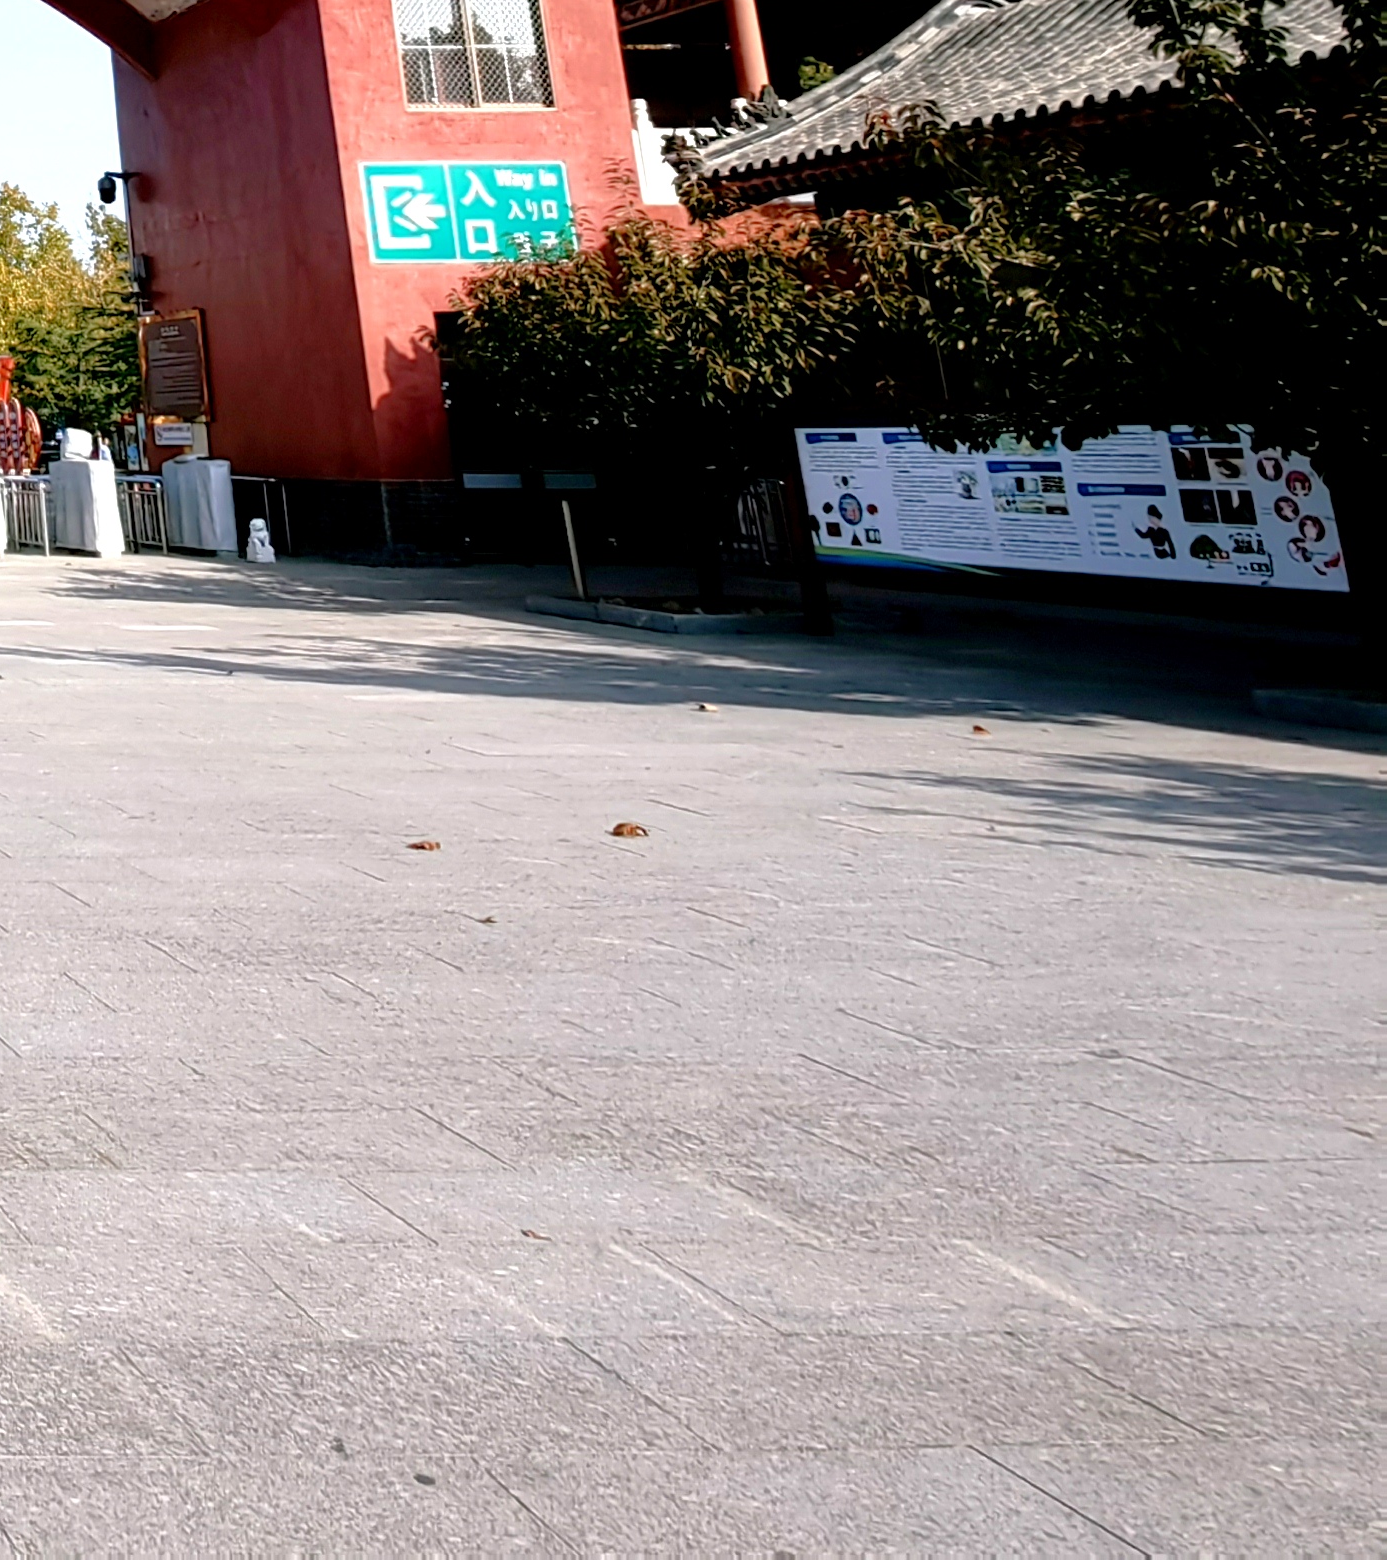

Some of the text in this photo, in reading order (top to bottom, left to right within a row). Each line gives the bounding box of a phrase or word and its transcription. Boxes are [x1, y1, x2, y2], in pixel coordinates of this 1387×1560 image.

[494, 169, 558, 191] Way in
[460, 170, 498, 254] 入口
[508, 198, 559, 221] 入り口
